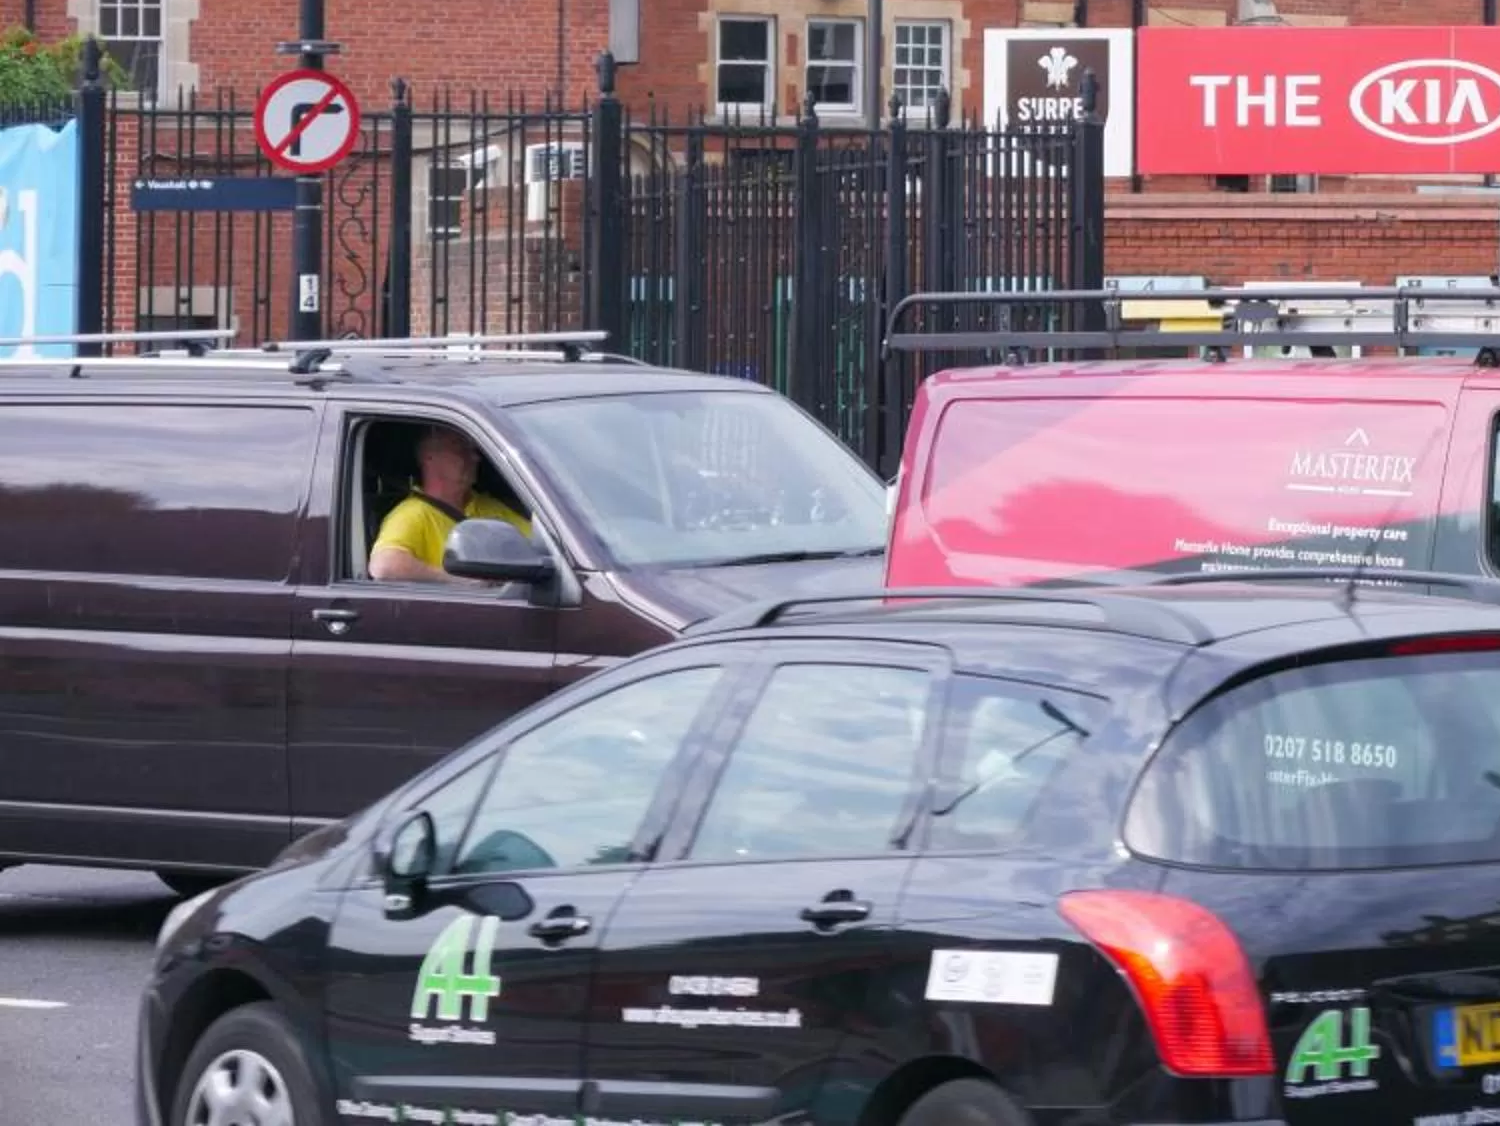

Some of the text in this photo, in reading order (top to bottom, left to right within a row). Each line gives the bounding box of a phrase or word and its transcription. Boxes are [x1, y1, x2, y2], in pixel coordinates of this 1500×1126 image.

[1189, 74, 1321, 127] THE
[1378, 78, 1489, 124] KIA
[1290, 452, 1416, 482] MASTERFIX
[1268, 517, 1408, 541] Exceptional property care
[1253, 544, 1295, 560] provides
[1297, 548, 1373, 567] comprehensive
[1375, 553, 1405, 567] home
[1264, 734, 1396, 768] 0207 518 8650
